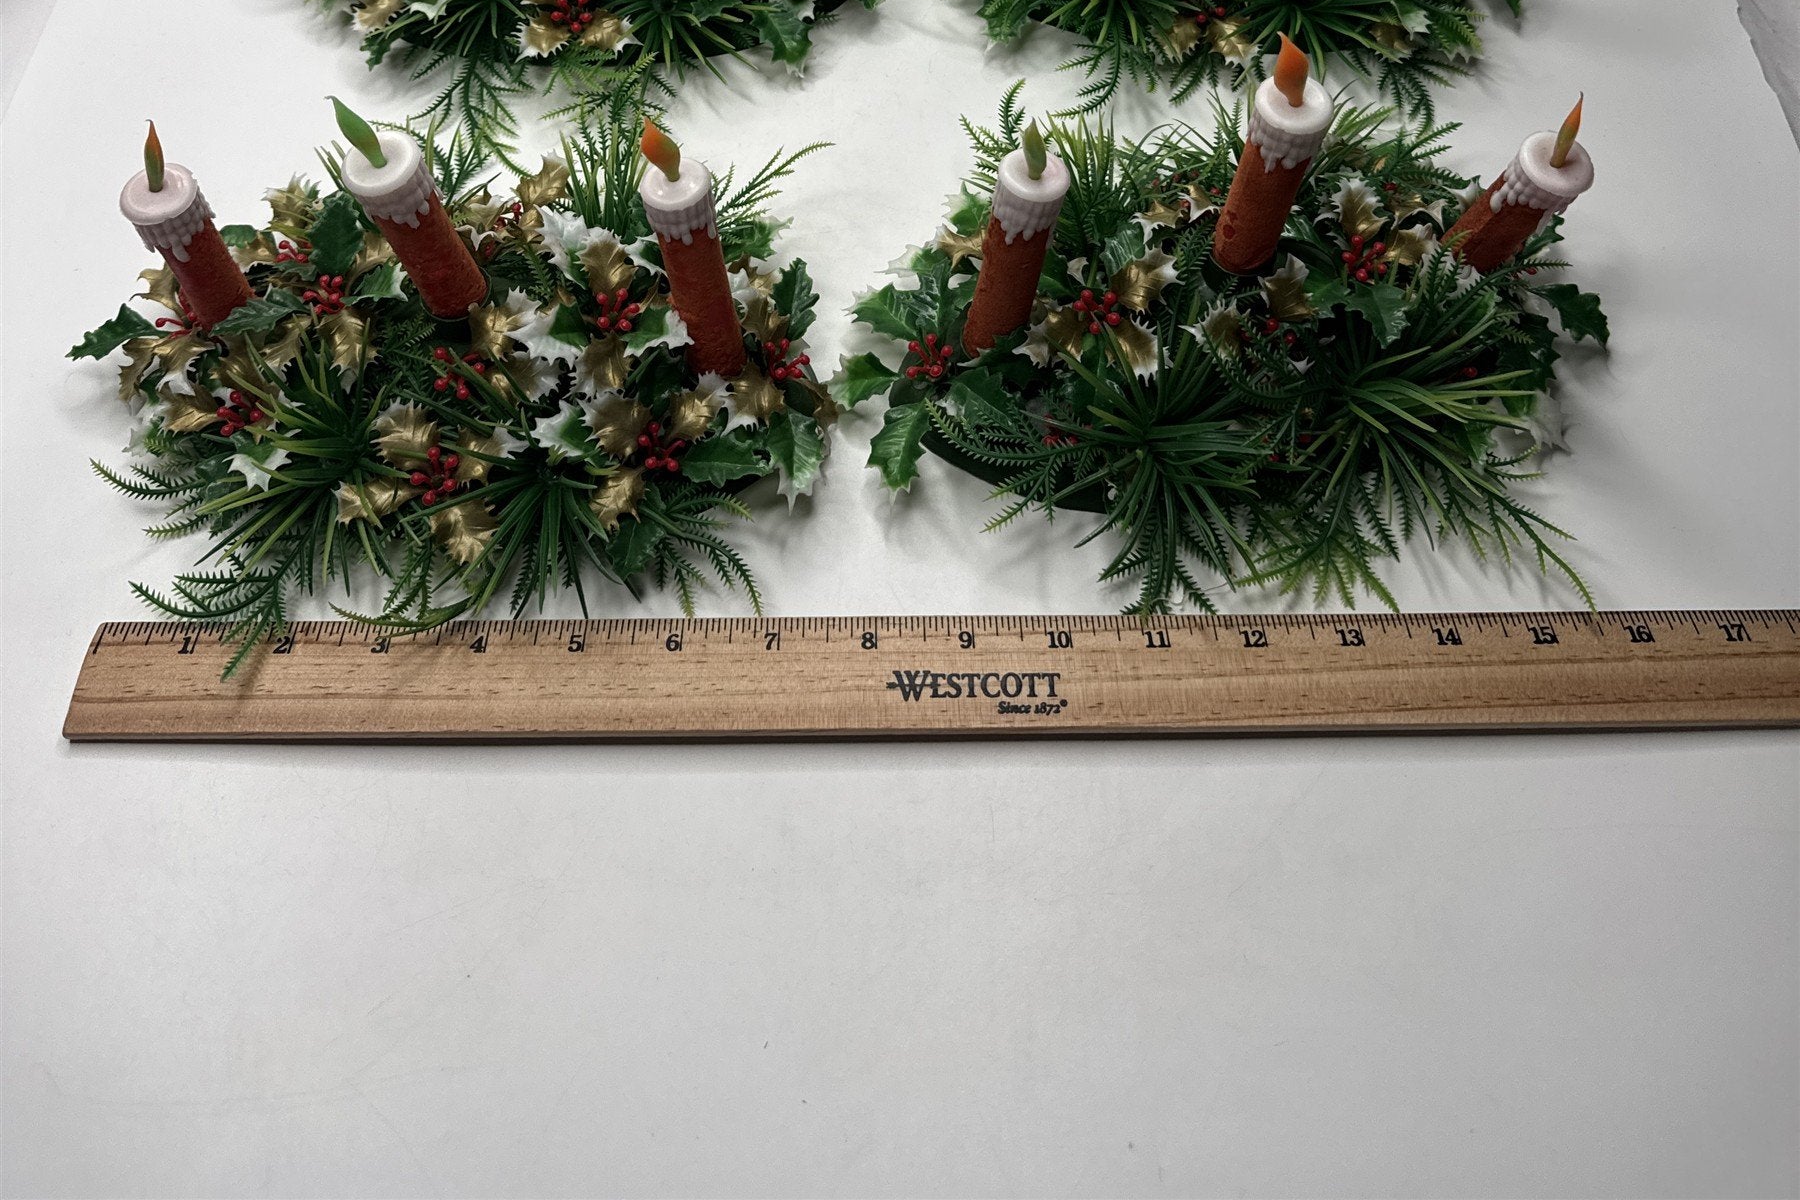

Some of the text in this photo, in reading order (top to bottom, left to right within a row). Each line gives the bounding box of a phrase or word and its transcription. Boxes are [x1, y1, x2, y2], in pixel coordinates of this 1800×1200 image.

[764, 632, 777, 650] 7
[861, 632, 875, 649] 8
[958, 631, 972, 648] 9
[1047, 631, 1069, 648] 10
[1144, 630, 1168, 648] 11
[1240, 630, 1265, 647] 12
[1336, 629, 1362, 646] 13
[1432, 628, 1459, 645] 14
[1528, 626, 1555, 644] 15
[1624, 625, 1650, 643] 16
[1719, 624, 1744, 641] 17
[177, 636, 191, 655] 1
[272, 636, 290, 654] 2
[371, 636, 388, 654] 3
[469, 636, 485, 653] 4
[568, 635, 582, 652] 5
[665, 634, 680, 651] 6
[891, 670, 1061, 701] WESTCOTT
[997, 701, 1031, 715] Since
